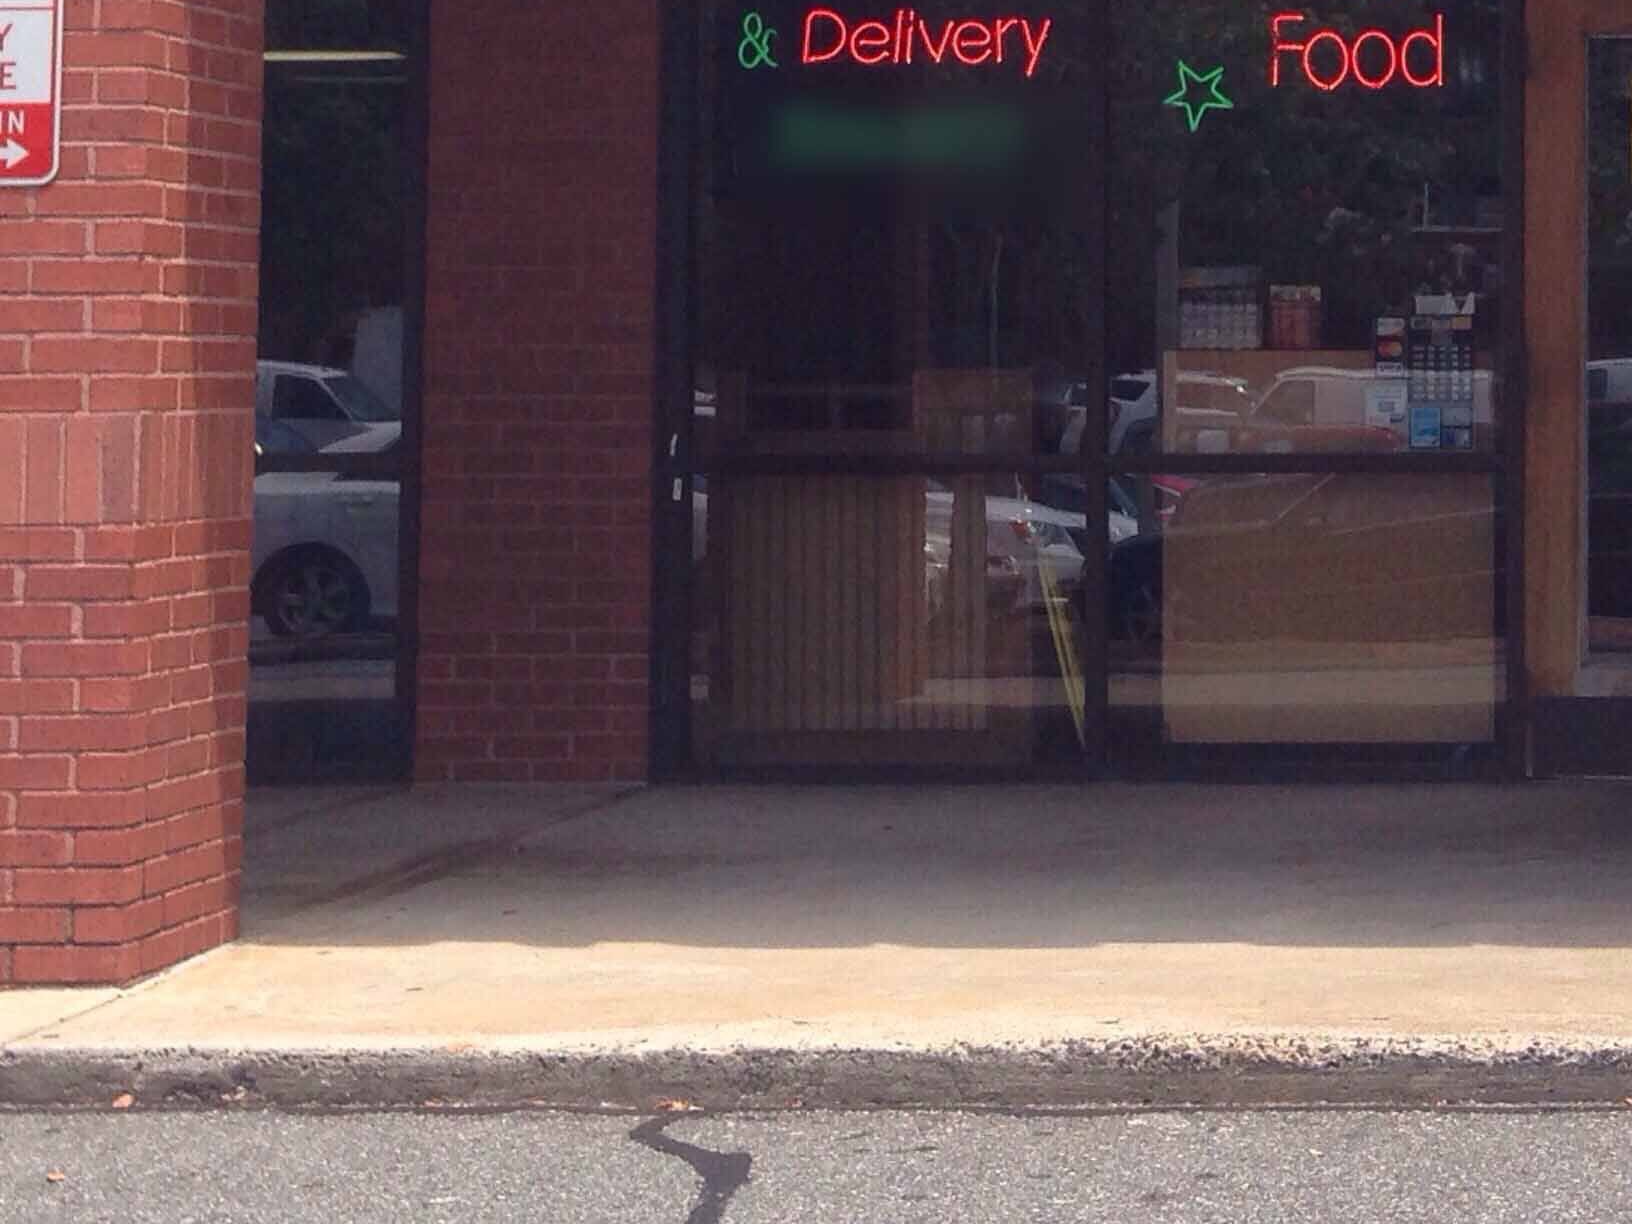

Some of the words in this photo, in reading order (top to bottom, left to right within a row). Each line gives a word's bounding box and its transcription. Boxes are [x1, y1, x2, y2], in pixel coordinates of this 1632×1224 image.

[736, 9, 778, 70] &
[800, 5, 1053, 78] Delivery
[1268, 10, 1446, 92] Food
